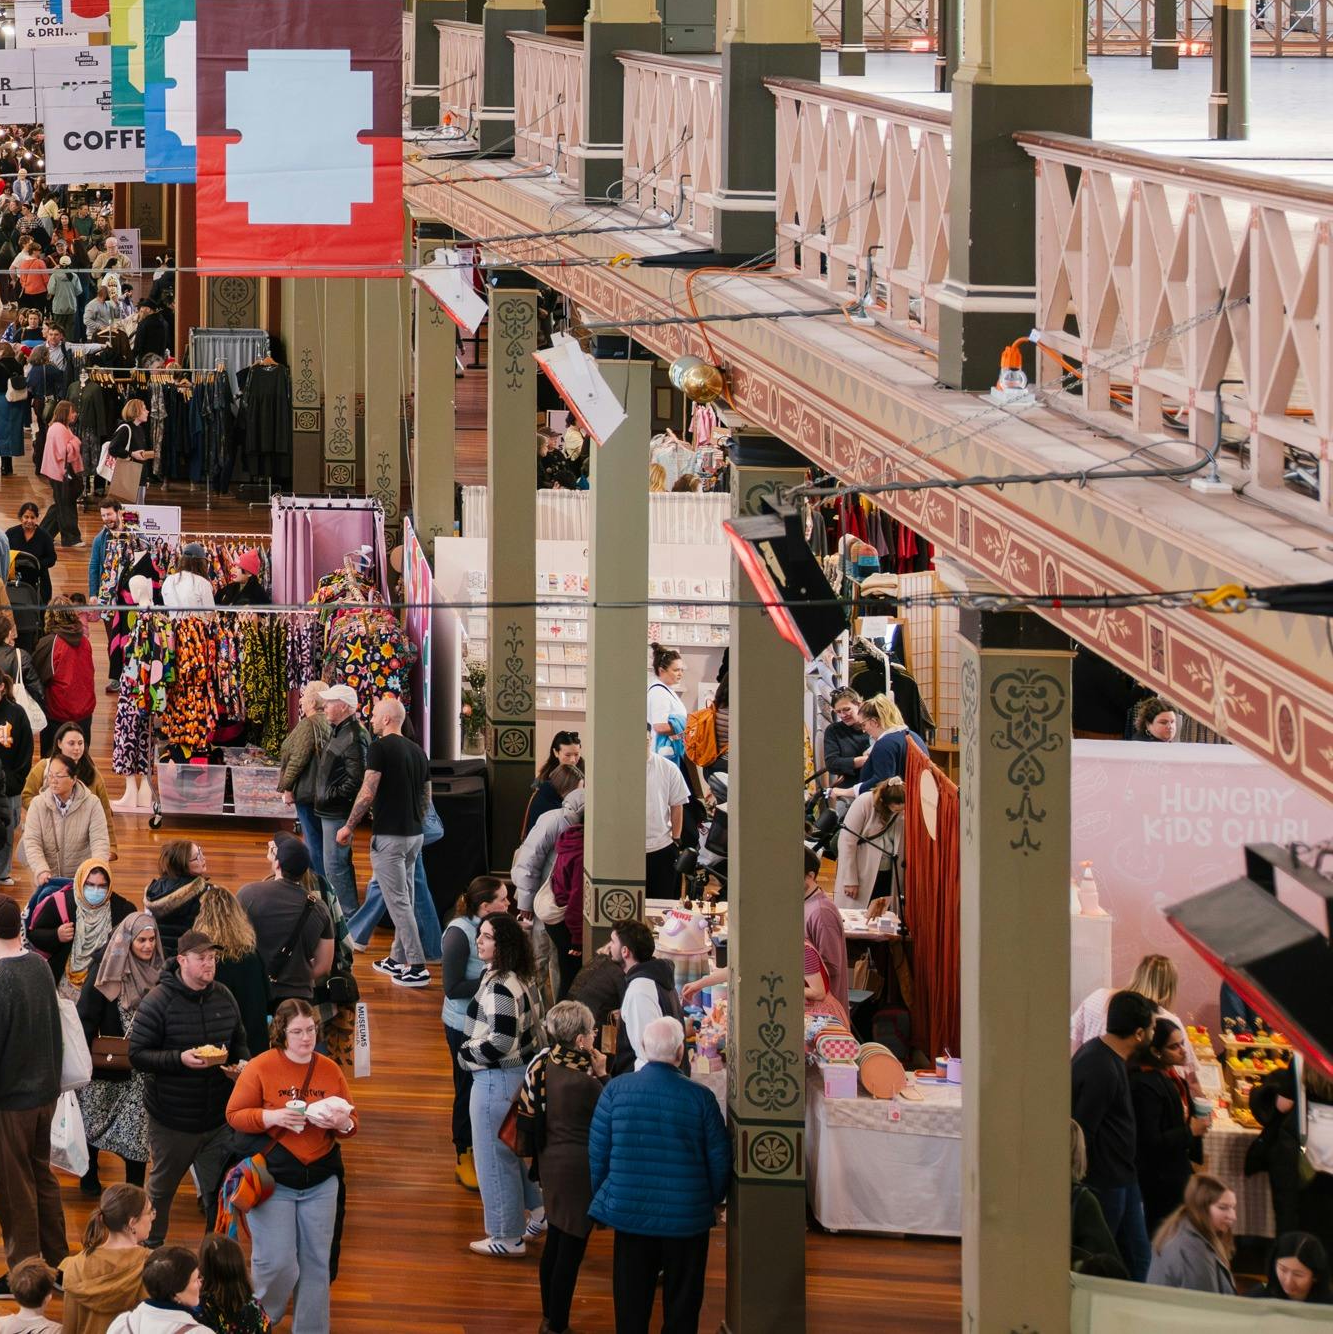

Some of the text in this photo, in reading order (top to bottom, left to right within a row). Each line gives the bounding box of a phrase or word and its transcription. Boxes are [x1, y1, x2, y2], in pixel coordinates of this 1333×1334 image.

[27, 28, 36, 37] &
[1160, 783, 1297, 815] HUNGRY
[358, 1006, 367, 1047] MUSEUMS
